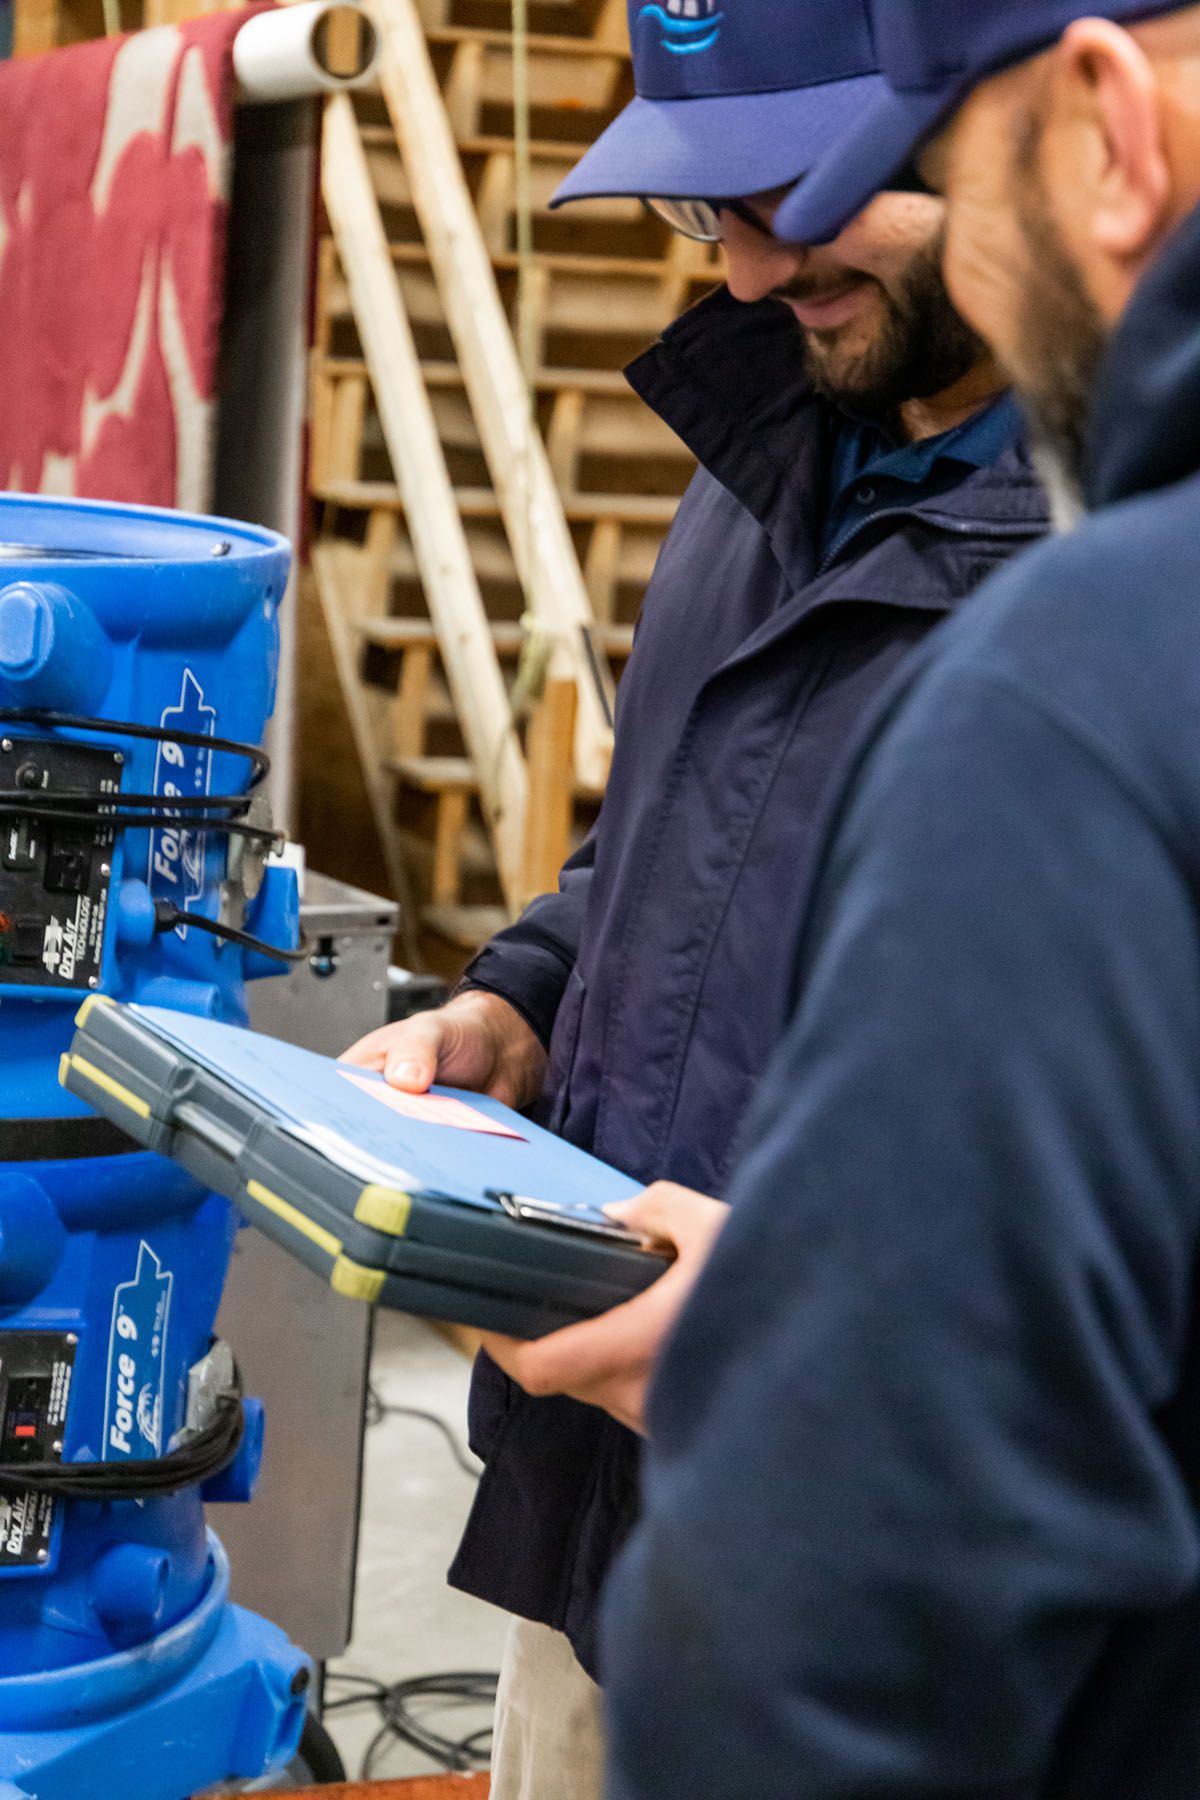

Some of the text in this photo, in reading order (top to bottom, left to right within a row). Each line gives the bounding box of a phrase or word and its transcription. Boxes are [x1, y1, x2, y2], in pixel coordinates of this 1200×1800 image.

[161, 741, 185, 768] 9
[58, 917, 76, 979] Dry Air
[110, 1314, 138, 1454] Force 9
[6, 1496, 25, 1555] Dry Air
